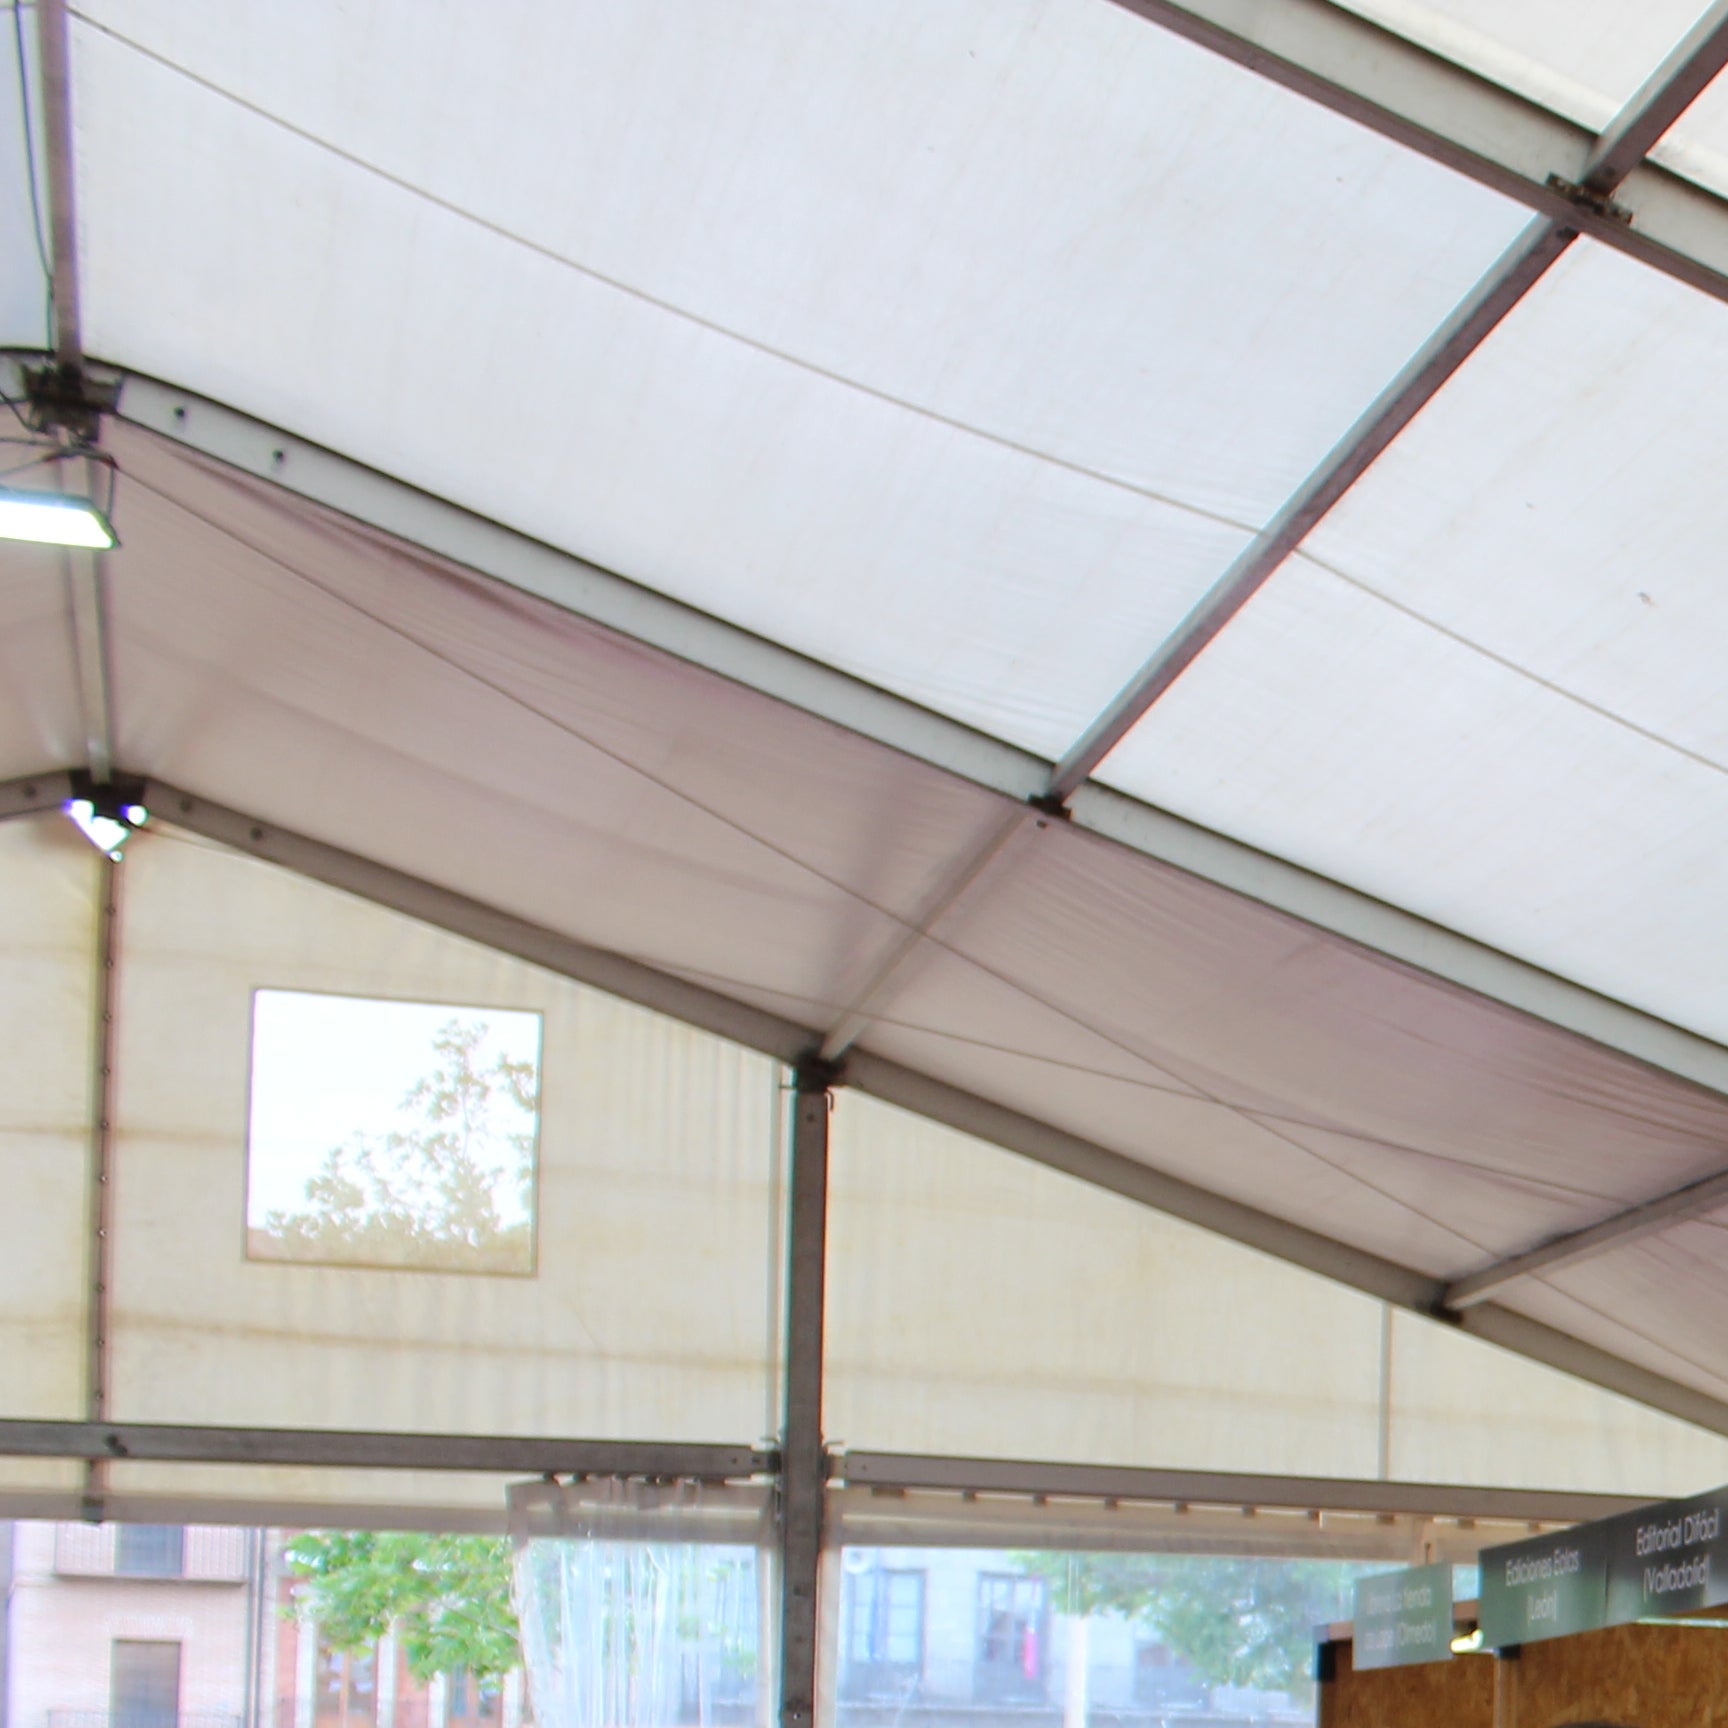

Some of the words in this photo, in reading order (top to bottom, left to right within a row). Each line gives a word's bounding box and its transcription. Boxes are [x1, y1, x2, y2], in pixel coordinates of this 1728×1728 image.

[1636, 1518, 1683, 1557] Editorial
[1505, 1556, 1552, 1587] Ediciones
[1642, 1551, 1710, 1604] (Valladolid)
